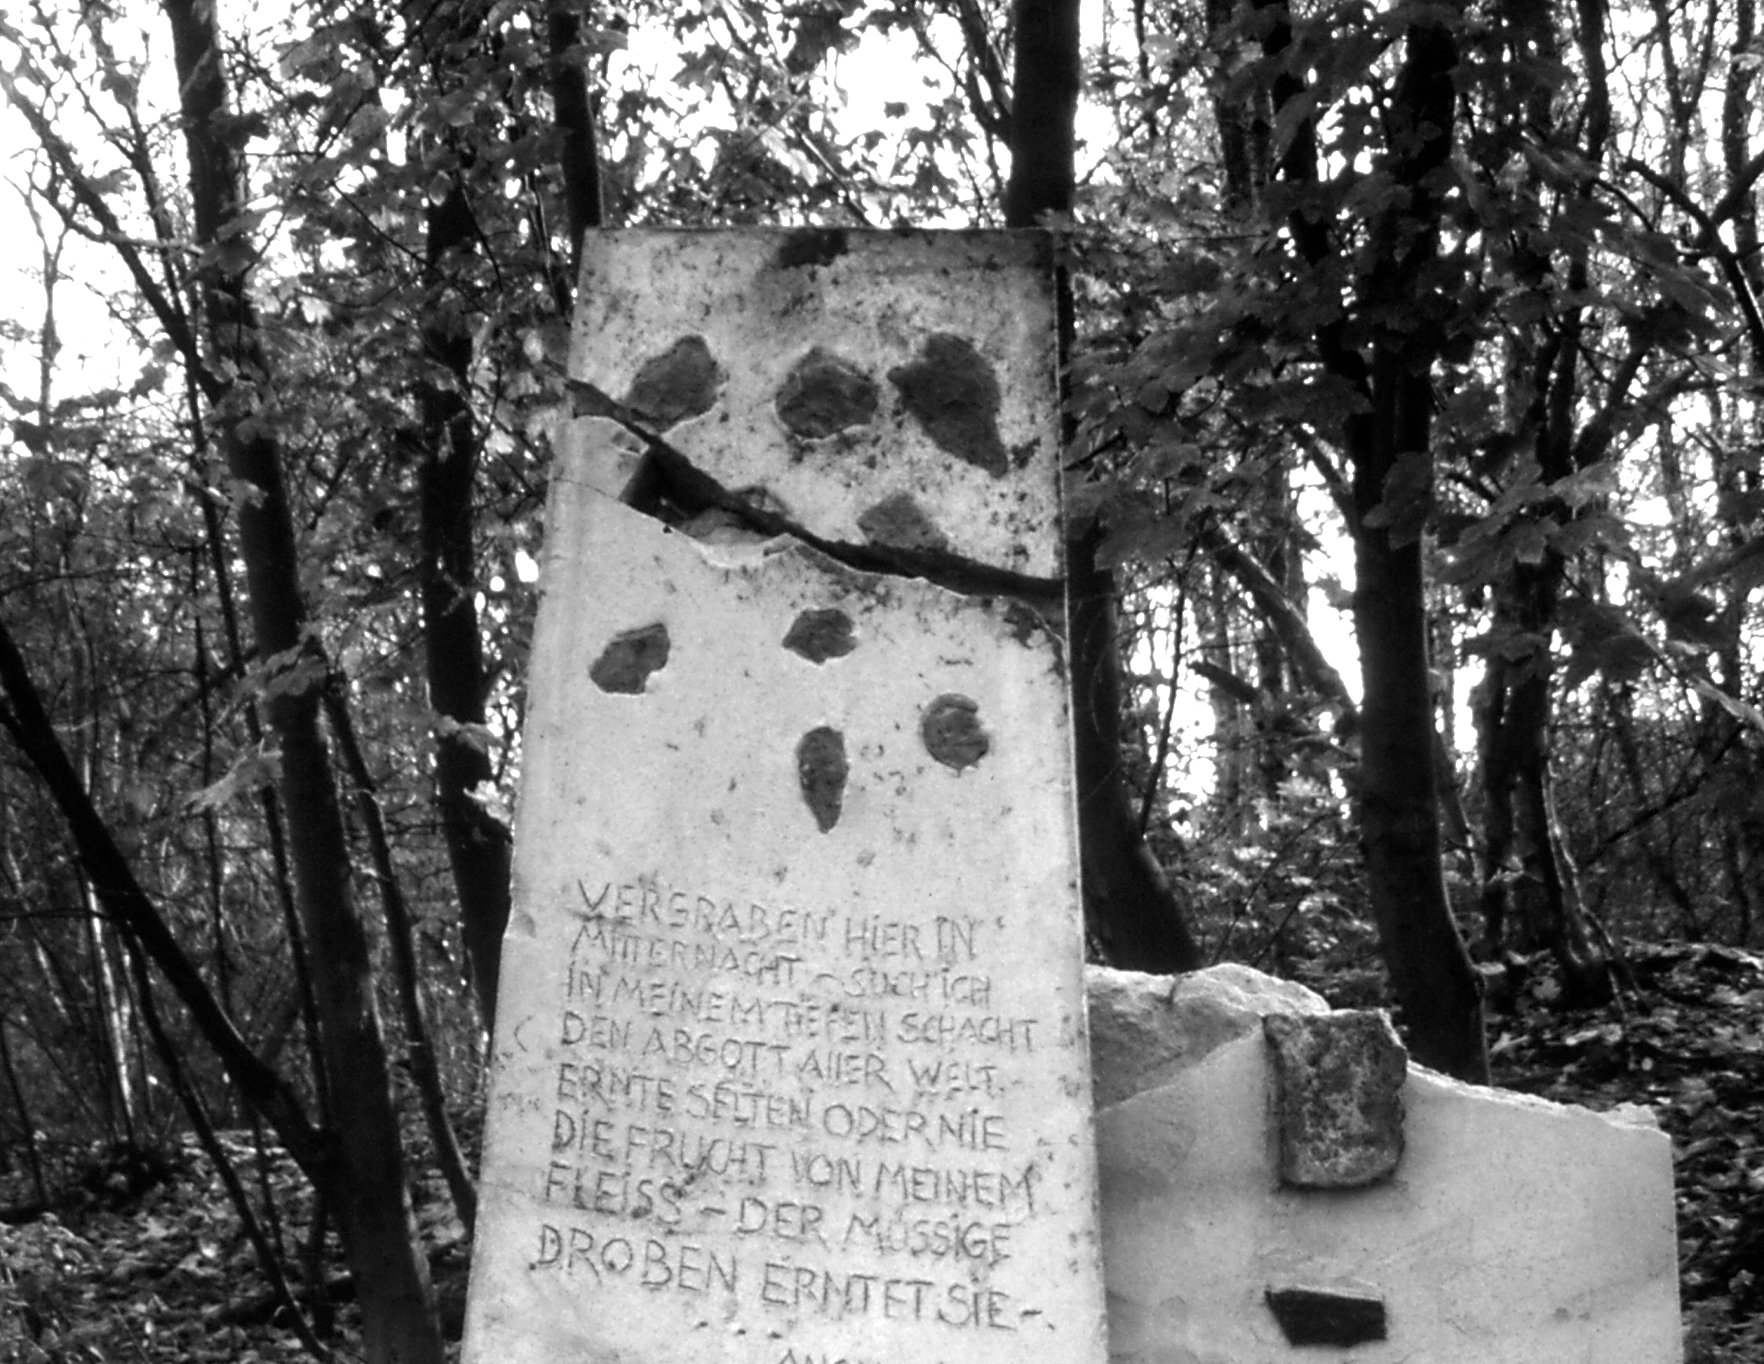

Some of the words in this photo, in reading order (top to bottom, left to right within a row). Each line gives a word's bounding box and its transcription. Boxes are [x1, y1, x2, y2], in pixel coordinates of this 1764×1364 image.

[577, 878, 829, 945] VERGRABEN
[935, 915, 977, 961] IN
[561, 1010, 631, 1050] DEN
[642, 1026, 792, 1071] ABGOTT
[897, 1012, 1039, 1053] SCHACHT
[557, 1063, 672, 1113] ERNTE
[823, 1104, 935, 1151] ODER
[551, 1109, 614, 1160] DIE
[624, 1124, 777, 1177] FRUCHT
[737, 1197, 831, 1250] DER
[535, 1224, 737, 1294] DROBEN
[761, 1262, 935, 1321] ERNTET
